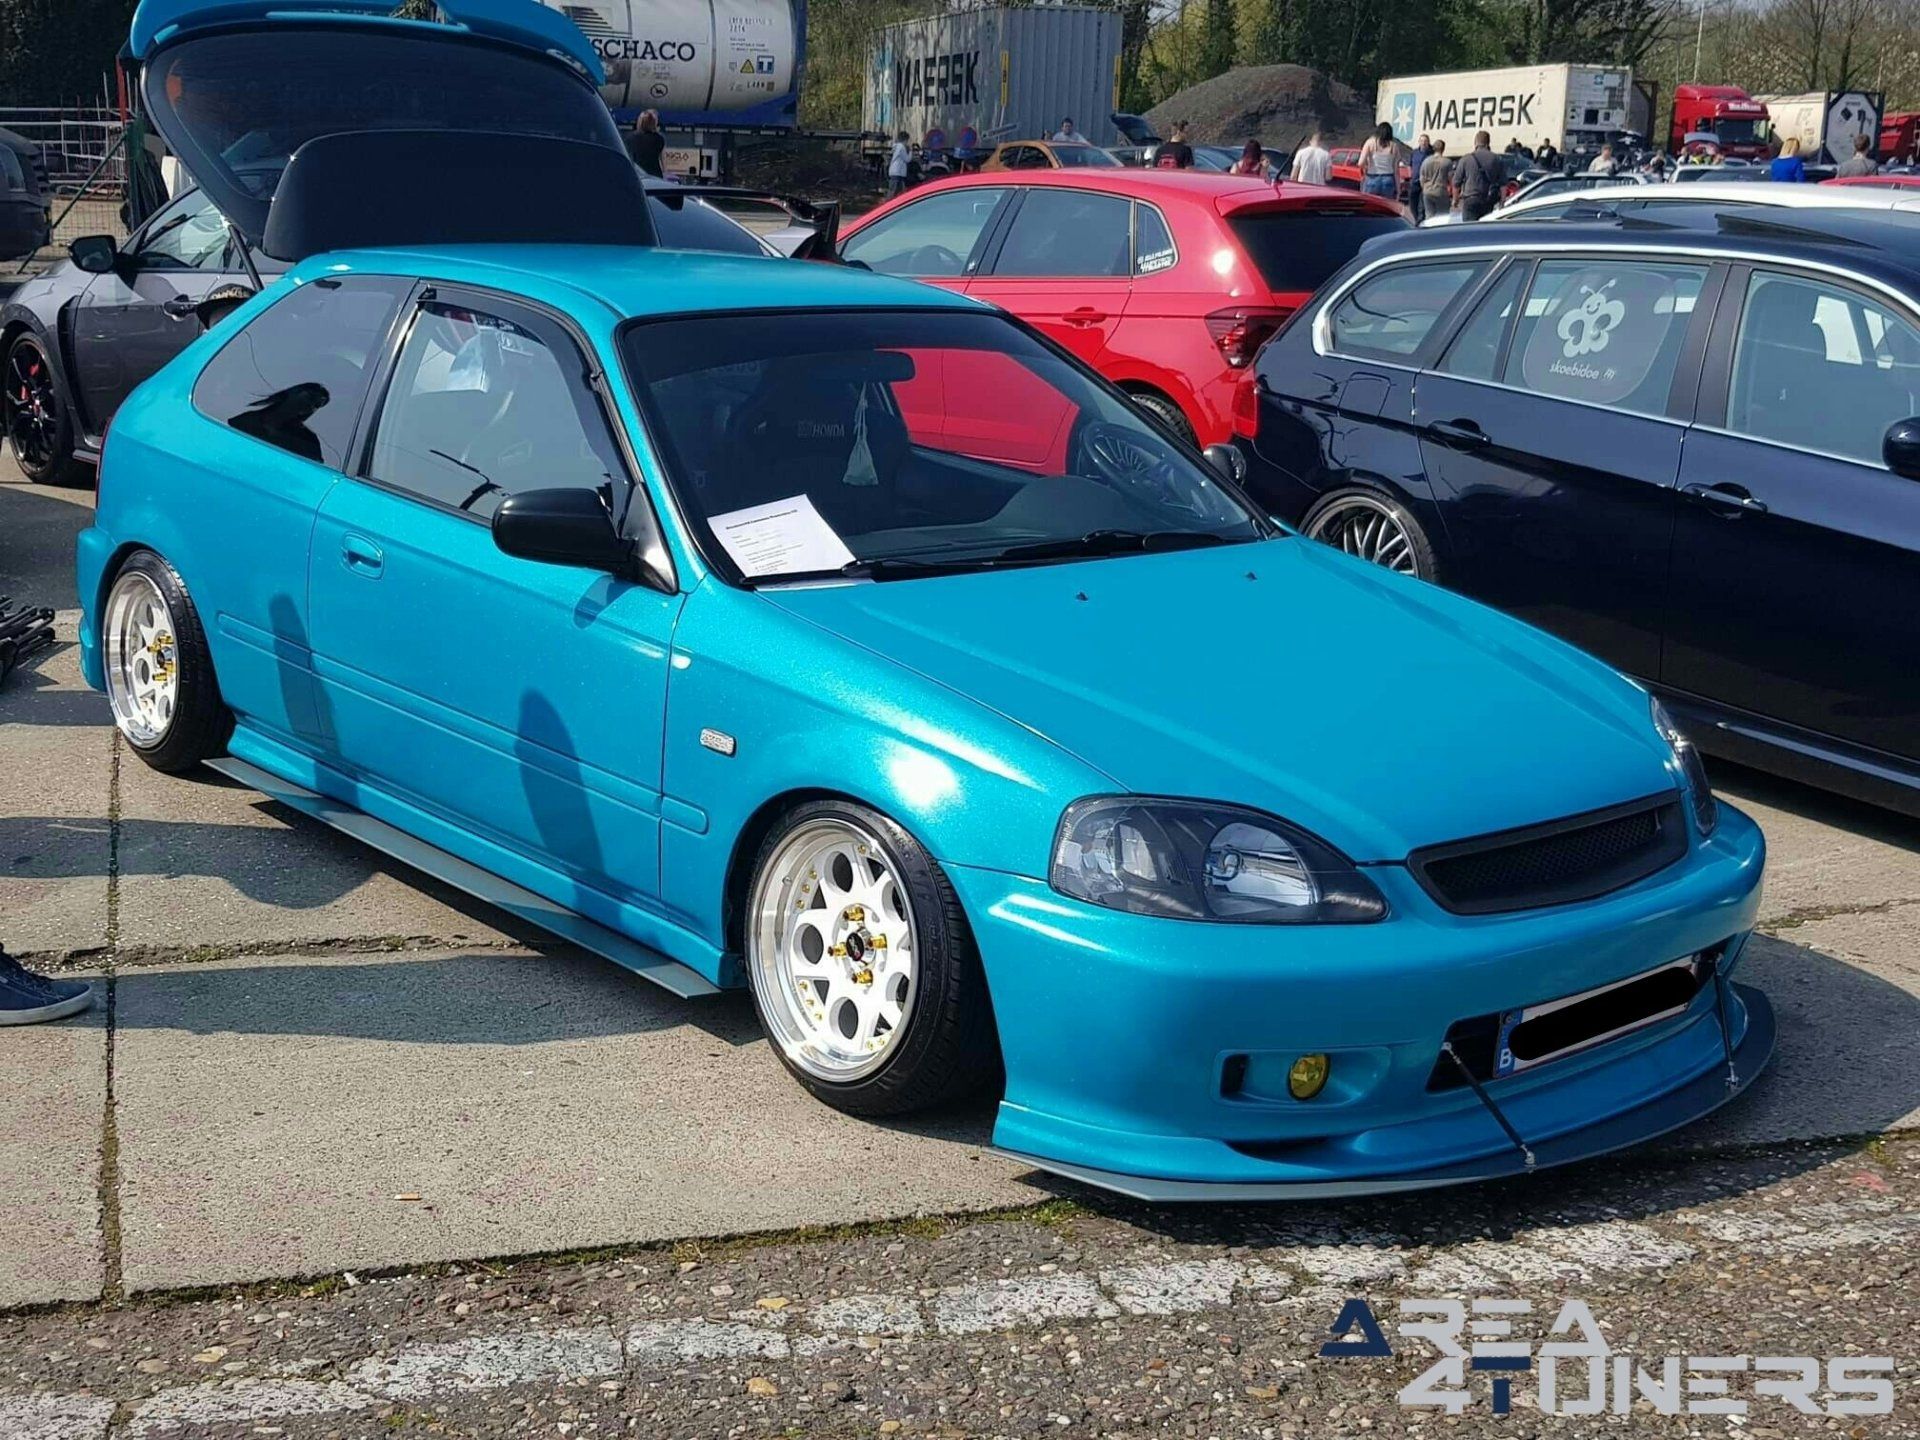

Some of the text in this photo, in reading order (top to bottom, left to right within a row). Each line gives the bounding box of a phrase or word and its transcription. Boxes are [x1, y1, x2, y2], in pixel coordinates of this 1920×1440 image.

[592, 39, 695, 62] SCHACO
[896, 51, 979, 108] MAERSK
[1423, 93, 1535, 131] MAERSK
[811, 423, 845, 438] HONDA
[1499, 1047, 1511, 1069] B
